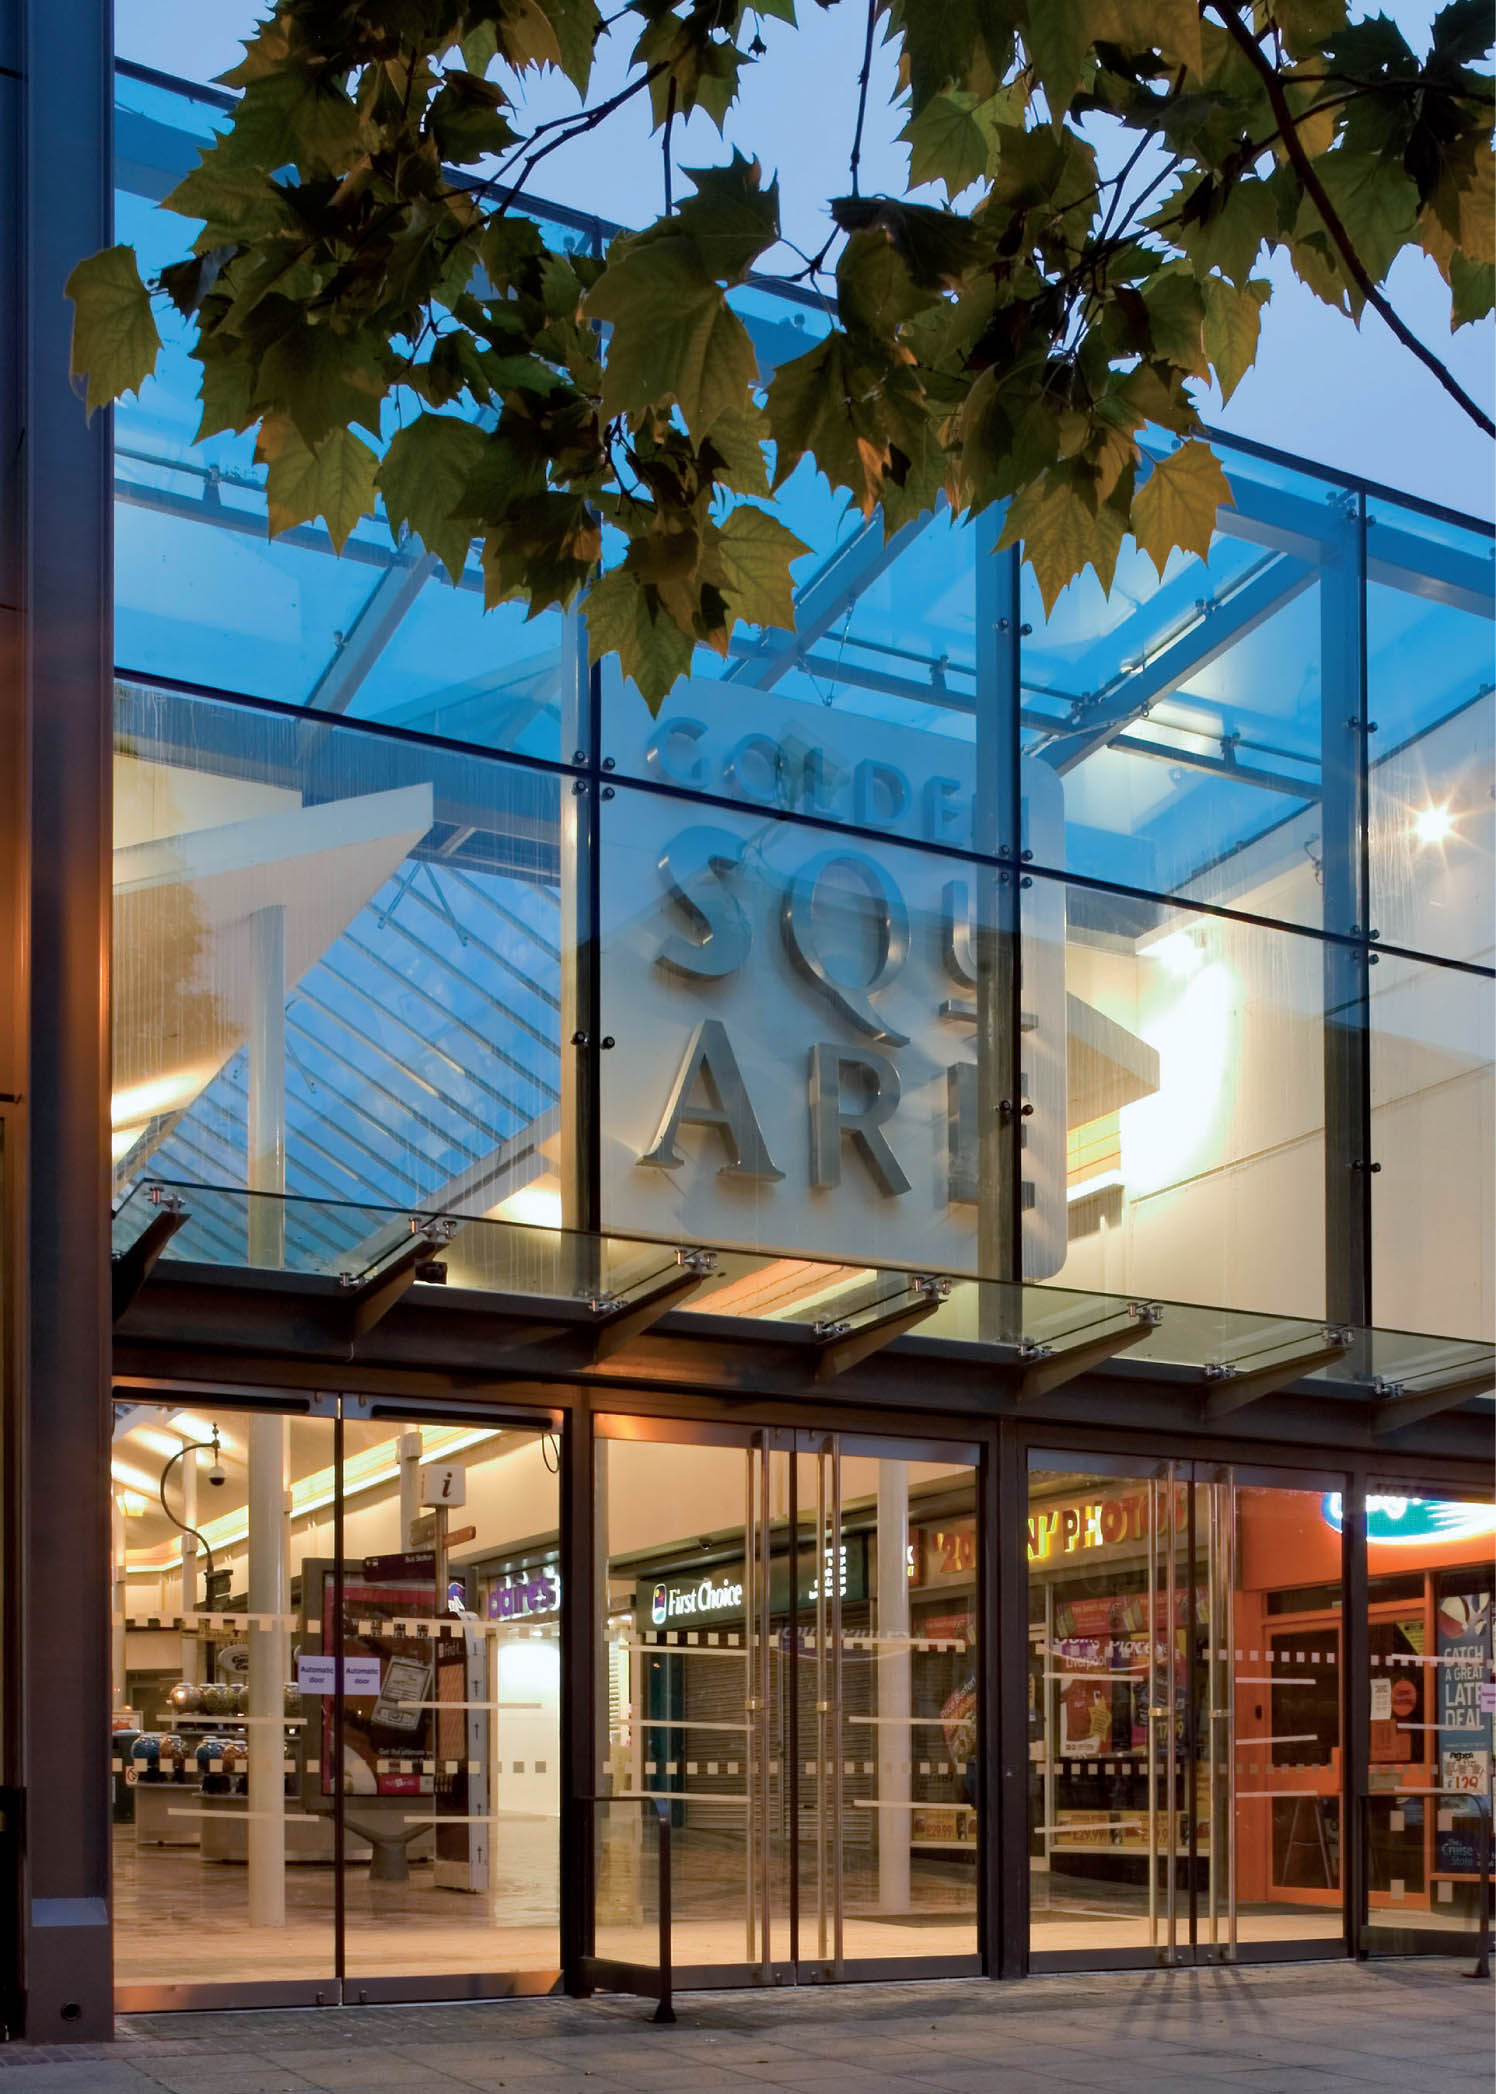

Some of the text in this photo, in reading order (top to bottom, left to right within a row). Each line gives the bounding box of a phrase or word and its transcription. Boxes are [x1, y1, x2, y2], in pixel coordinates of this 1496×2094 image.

[647, 715, 1029, 847] GOLDE
[635, 1018, 1037, 1211] ARE
[668, 1578, 743, 1617] First Choice
[1444, 1645, 1484, 1667] CATCH
[300, 1666, 334, 1674] Automatic
[309, 1676, 325, 1685] door
[346, 1667, 379, 1675] Automatic
[1445, 1666, 1483, 1681] A GREAT
[1445, 1682, 1482, 1707] LATE
[1445, 1708, 1481, 1730] DEAL
